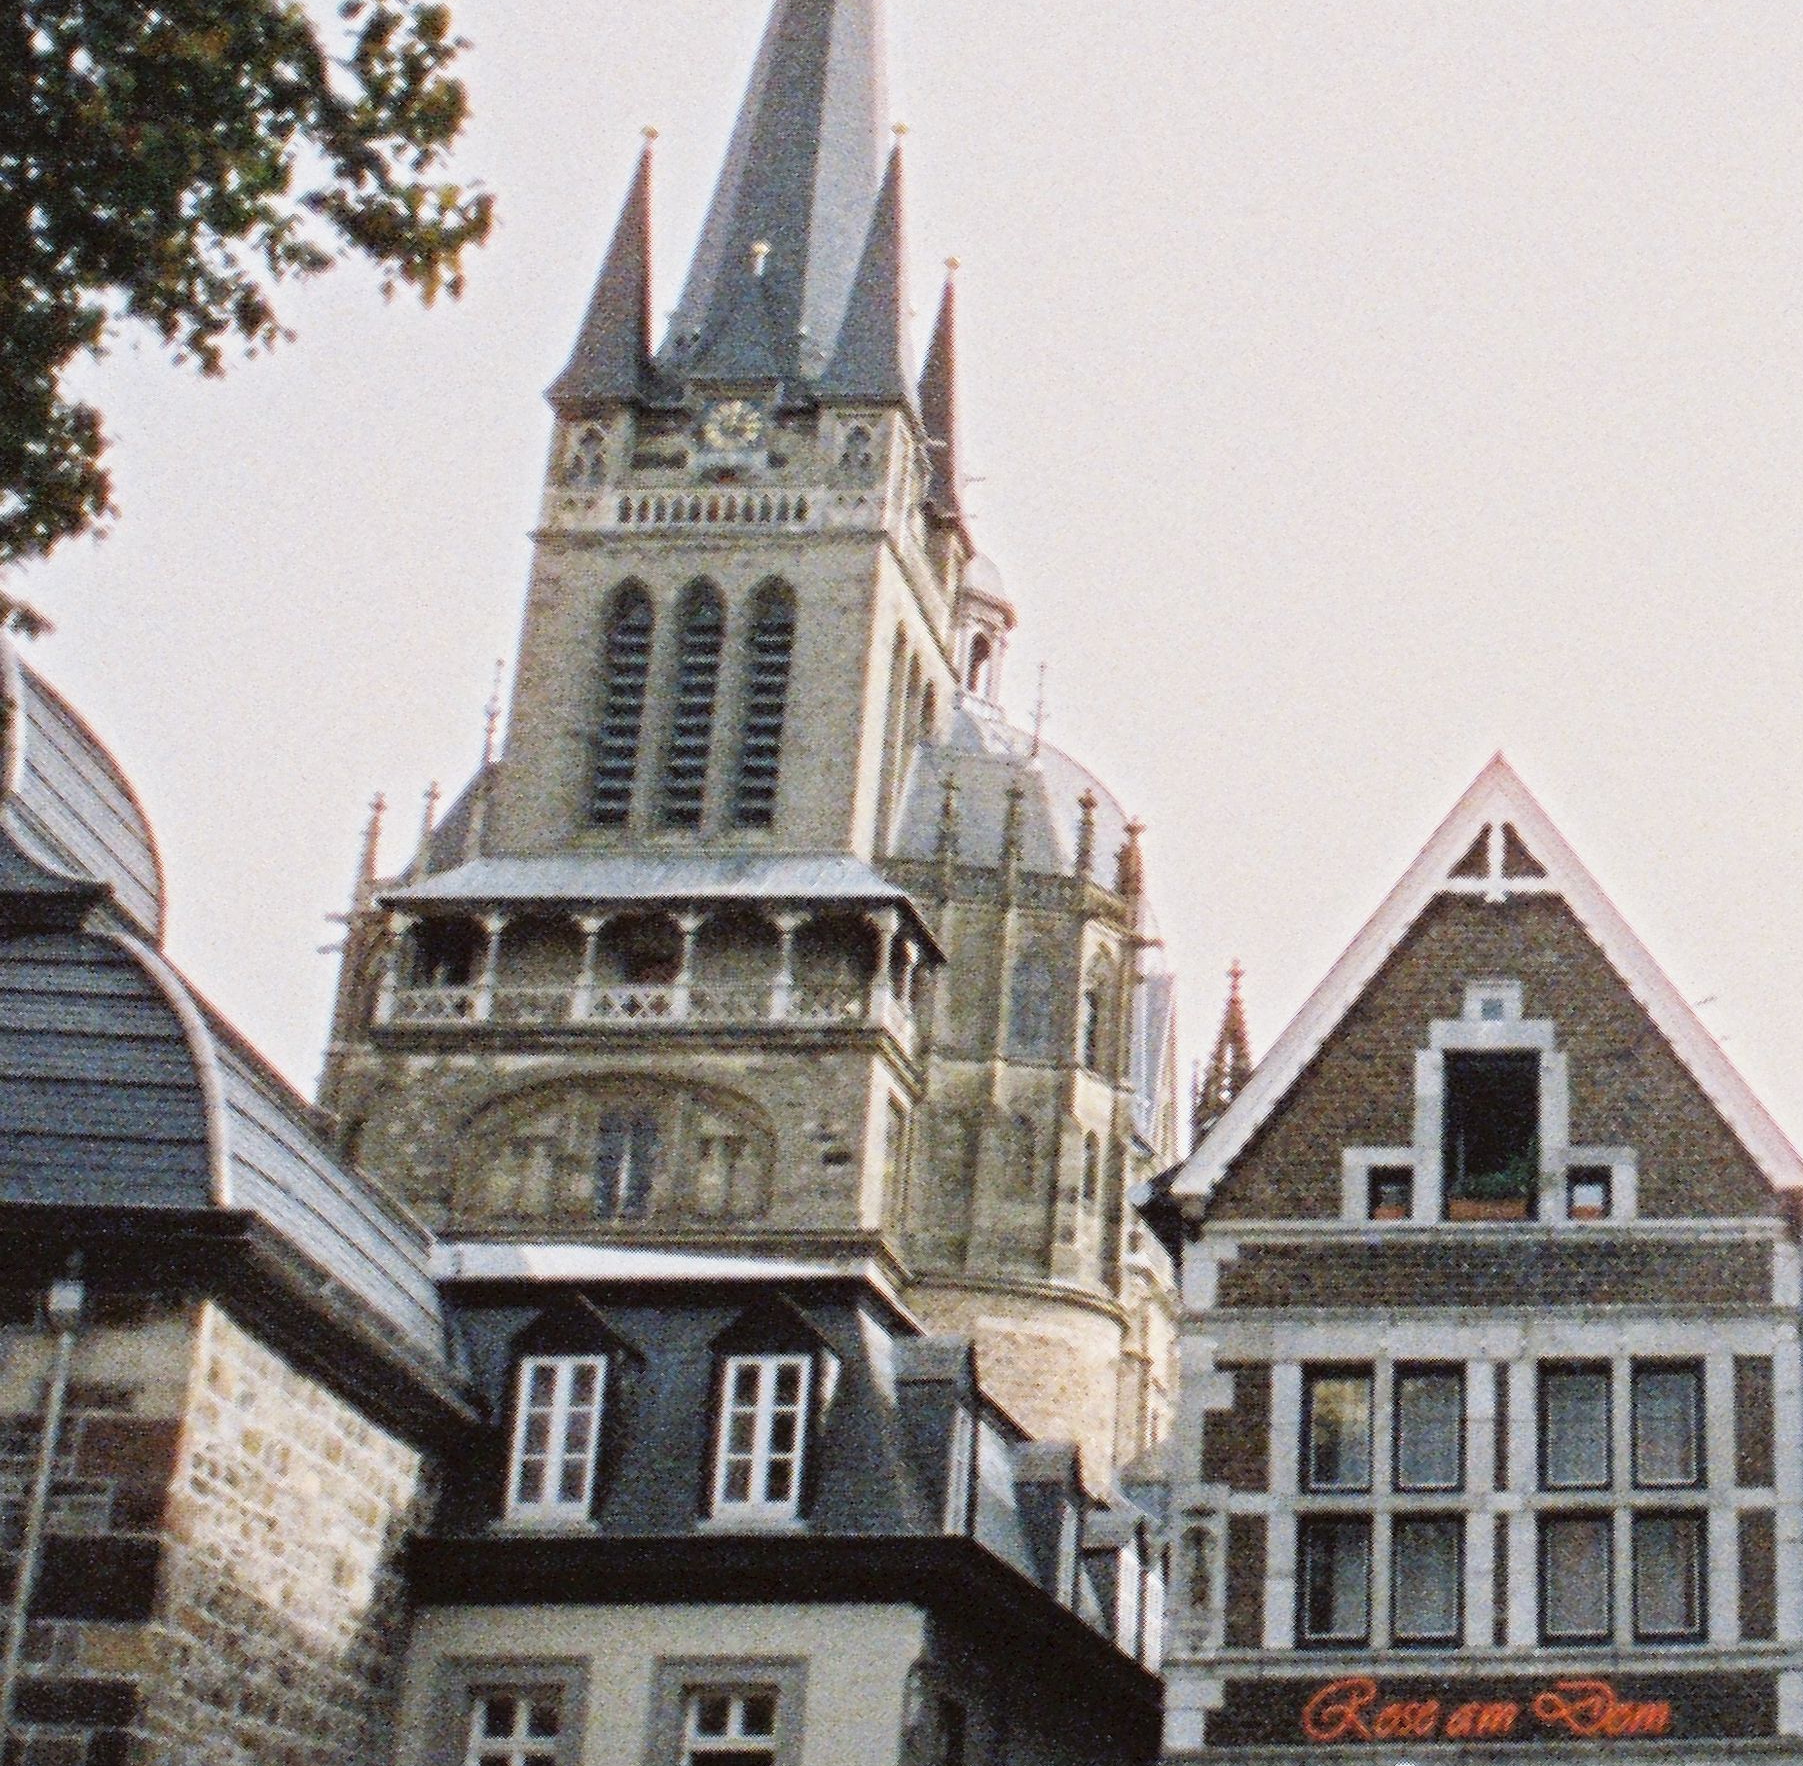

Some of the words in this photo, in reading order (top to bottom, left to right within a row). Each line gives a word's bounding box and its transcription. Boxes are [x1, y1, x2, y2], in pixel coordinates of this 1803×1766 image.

[1302, 1676, 1441, 1742] Rose
[1445, 1698, 1520, 1739] am
[1532, 1679, 1672, 1737] Dom
